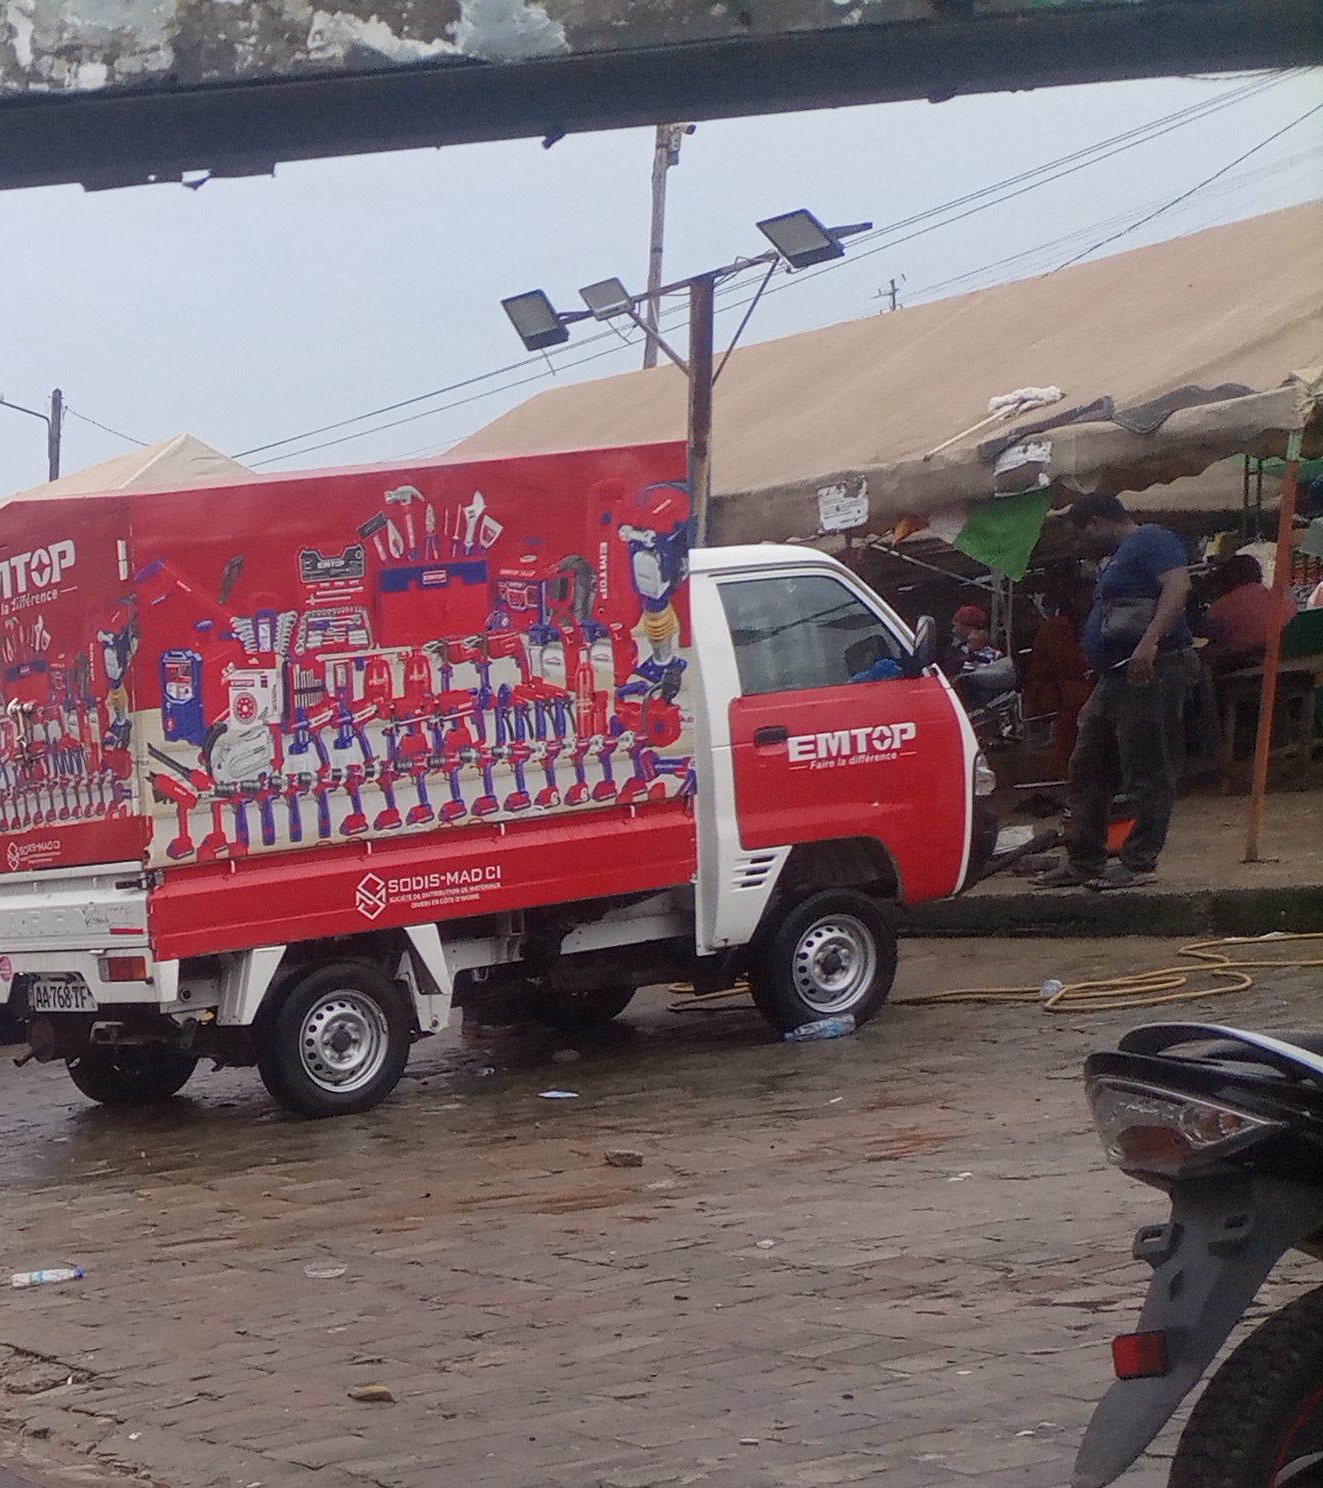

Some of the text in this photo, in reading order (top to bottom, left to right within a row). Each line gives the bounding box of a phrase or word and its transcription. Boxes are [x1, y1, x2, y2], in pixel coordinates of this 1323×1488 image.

[1, 602, 9, 616] la
[787, 722, 917, 763] EMTOP
[810, 751, 898, 770] Faire la différence
[388, 865, 502, 893] SODIS-MAD CI
